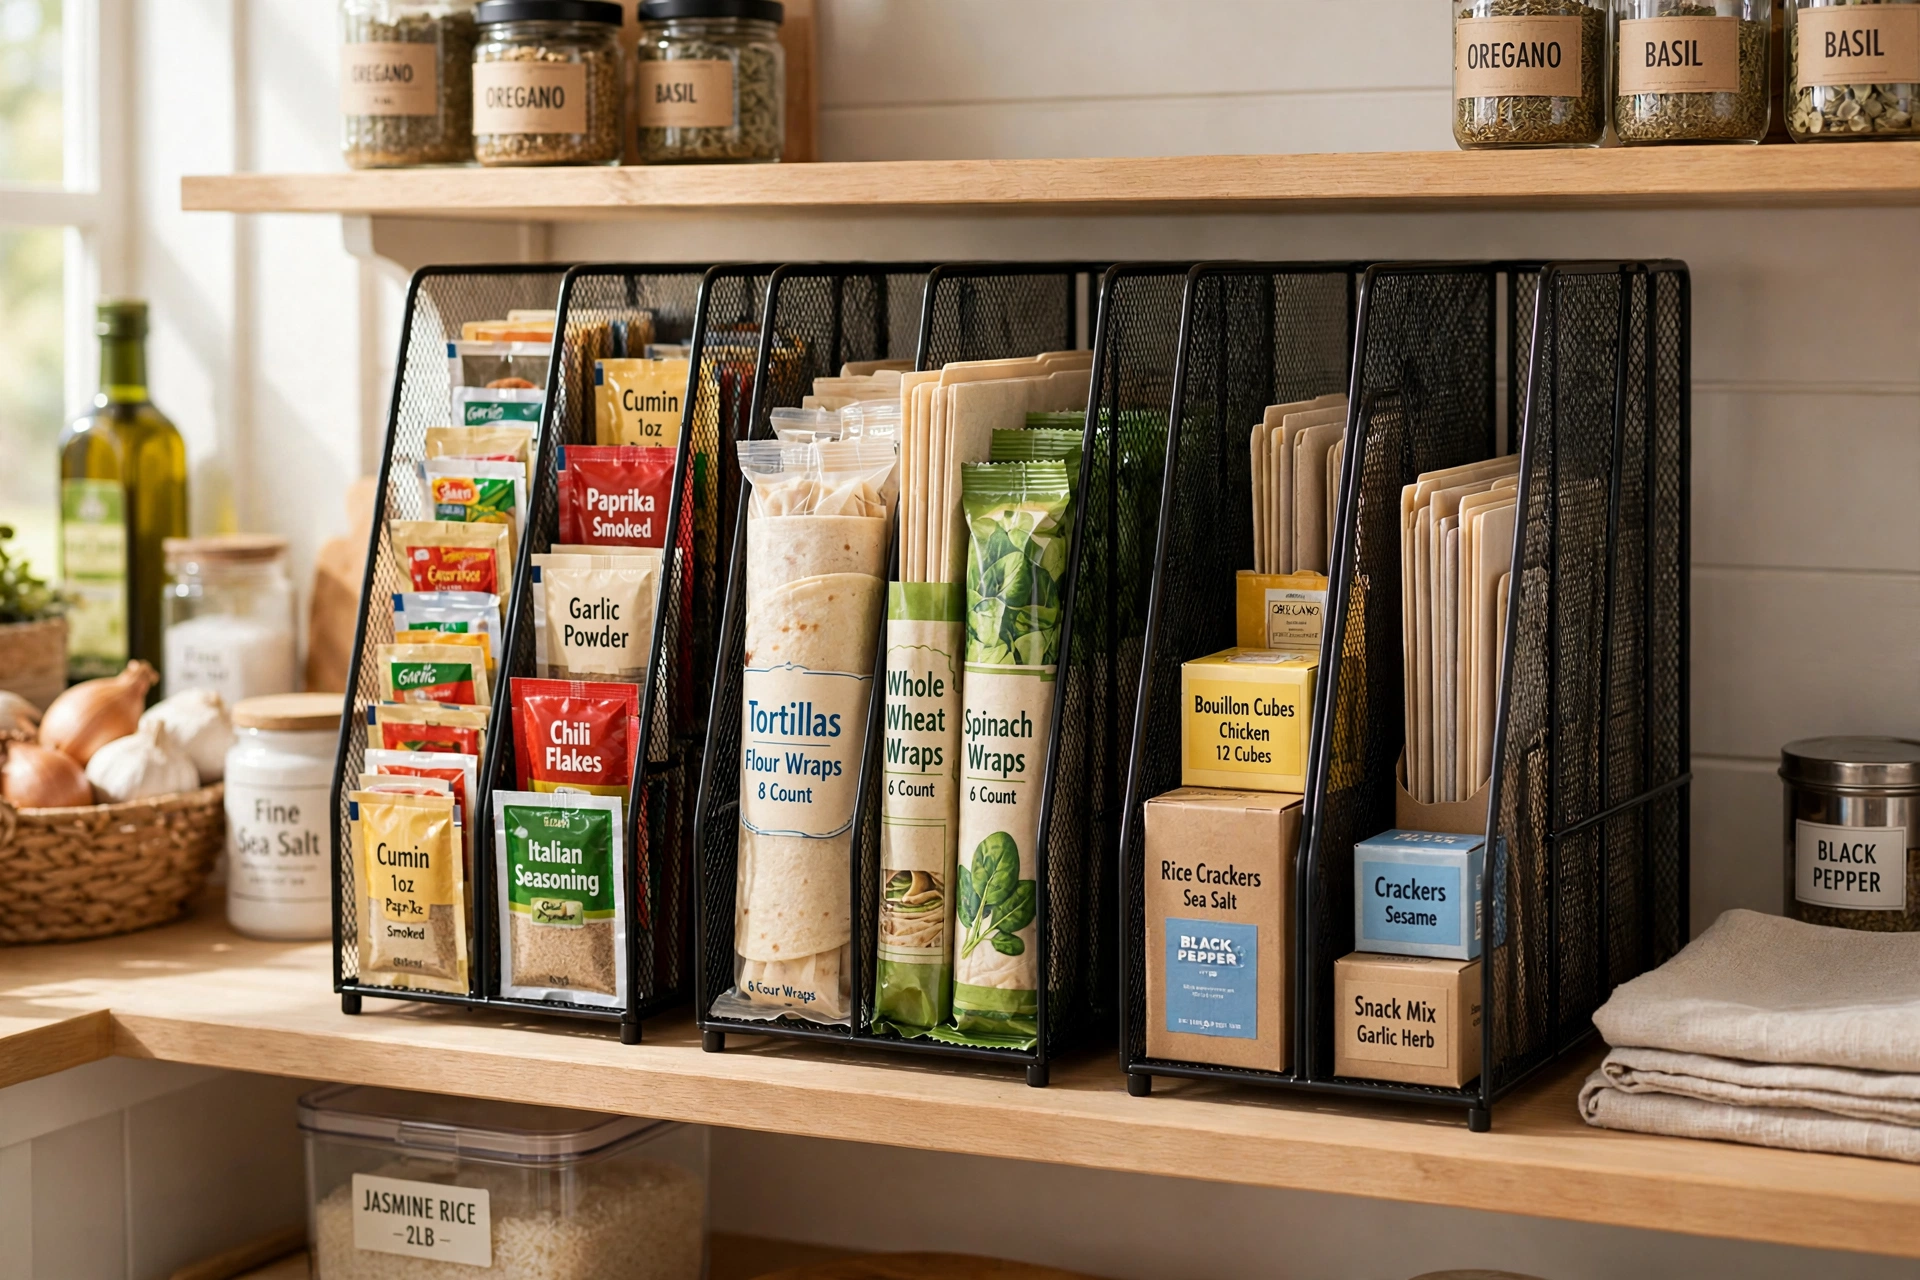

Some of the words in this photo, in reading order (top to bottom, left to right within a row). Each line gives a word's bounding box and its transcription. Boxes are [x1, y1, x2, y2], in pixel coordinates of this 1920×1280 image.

[1467, 41, 1562, 71] OREGANO
[1645, 40, 1703, 68] BASIL
[1824, 28, 1885, 58] BASIL
[486, 85, 565, 110] OREGANO
[655, 82, 697, 104] BASIL
[623, 388, 678, 413] Cumin
[637, 418, 663, 437] 1oz
[586, 488, 655, 518] Paprika
[592, 517, 652, 539] Smoked
[569, 597, 620, 621] Garlic
[563, 623, 629, 649] Powder
[887, 670, 944, 698] Whole
[748, 700, 841, 737] Tortillas
[886, 703, 945, 732] Wheat
[1194, 695, 1249, 716] Bouillon
[1253, 697, 1295, 718] Cubes
[549, 719, 591, 747] Chili
[965, 708, 1033, 742] Spinach
[1219, 721, 1270, 742] Chicken
[545, 746, 602, 773] Flakes
[745, 748, 780, 773] Flour
[785, 752, 842, 782] Wraps
[886, 737, 943, 772] Wraps
[968, 742, 1026, 779] Wraps
[1216, 745, 1231, 761] 12
[1234, 745, 1272, 764] Cubes
[758, 782, 766, 800] 8
[770, 783, 812, 804] Count
[888, 780, 895, 796] 6
[898, 780, 935, 798] Count
[969, 786, 976, 802] 6
[979, 786, 1017, 805] Count
[254, 798, 301, 824] Fine
[237, 827, 270, 857] Sea
[277, 829, 321, 857] Salt
[528, 838, 583, 865] Italian
[1818, 839, 1877, 865] BLACK
[377, 842, 430, 869] Cumin
[391, 874, 415, 893] 1oz
[514, 863, 600, 897] Seasoning
[1161, 860, 1193, 882] Rice
[1196, 862, 1262, 888] Crackers
[1813, 866, 1881, 893] PEPPER
[1183, 888, 1207, 908] Sea
[1210, 890, 1238, 910] Salt
[1374, 876, 1447, 902] Crackers
[1385, 905, 1438, 926] Sesame
[387, 924, 425, 941] Smoked
[1180, 935, 1233, 953] BLACK
[1177, 949, 1238, 966] PEPPER
[782, 984, 817, 1005] Wraps
[1354, 995, 1402, 1020] Snack
[1406, 1000, 1437, 1024] Mix
[1356, 1024, 1398, 1046] Garlic
[1401, 1029, 1436, 1049] Herb
[363, 1189, 434, 1220] JASMINE
[439, 1199, 477, 1225] RICE
